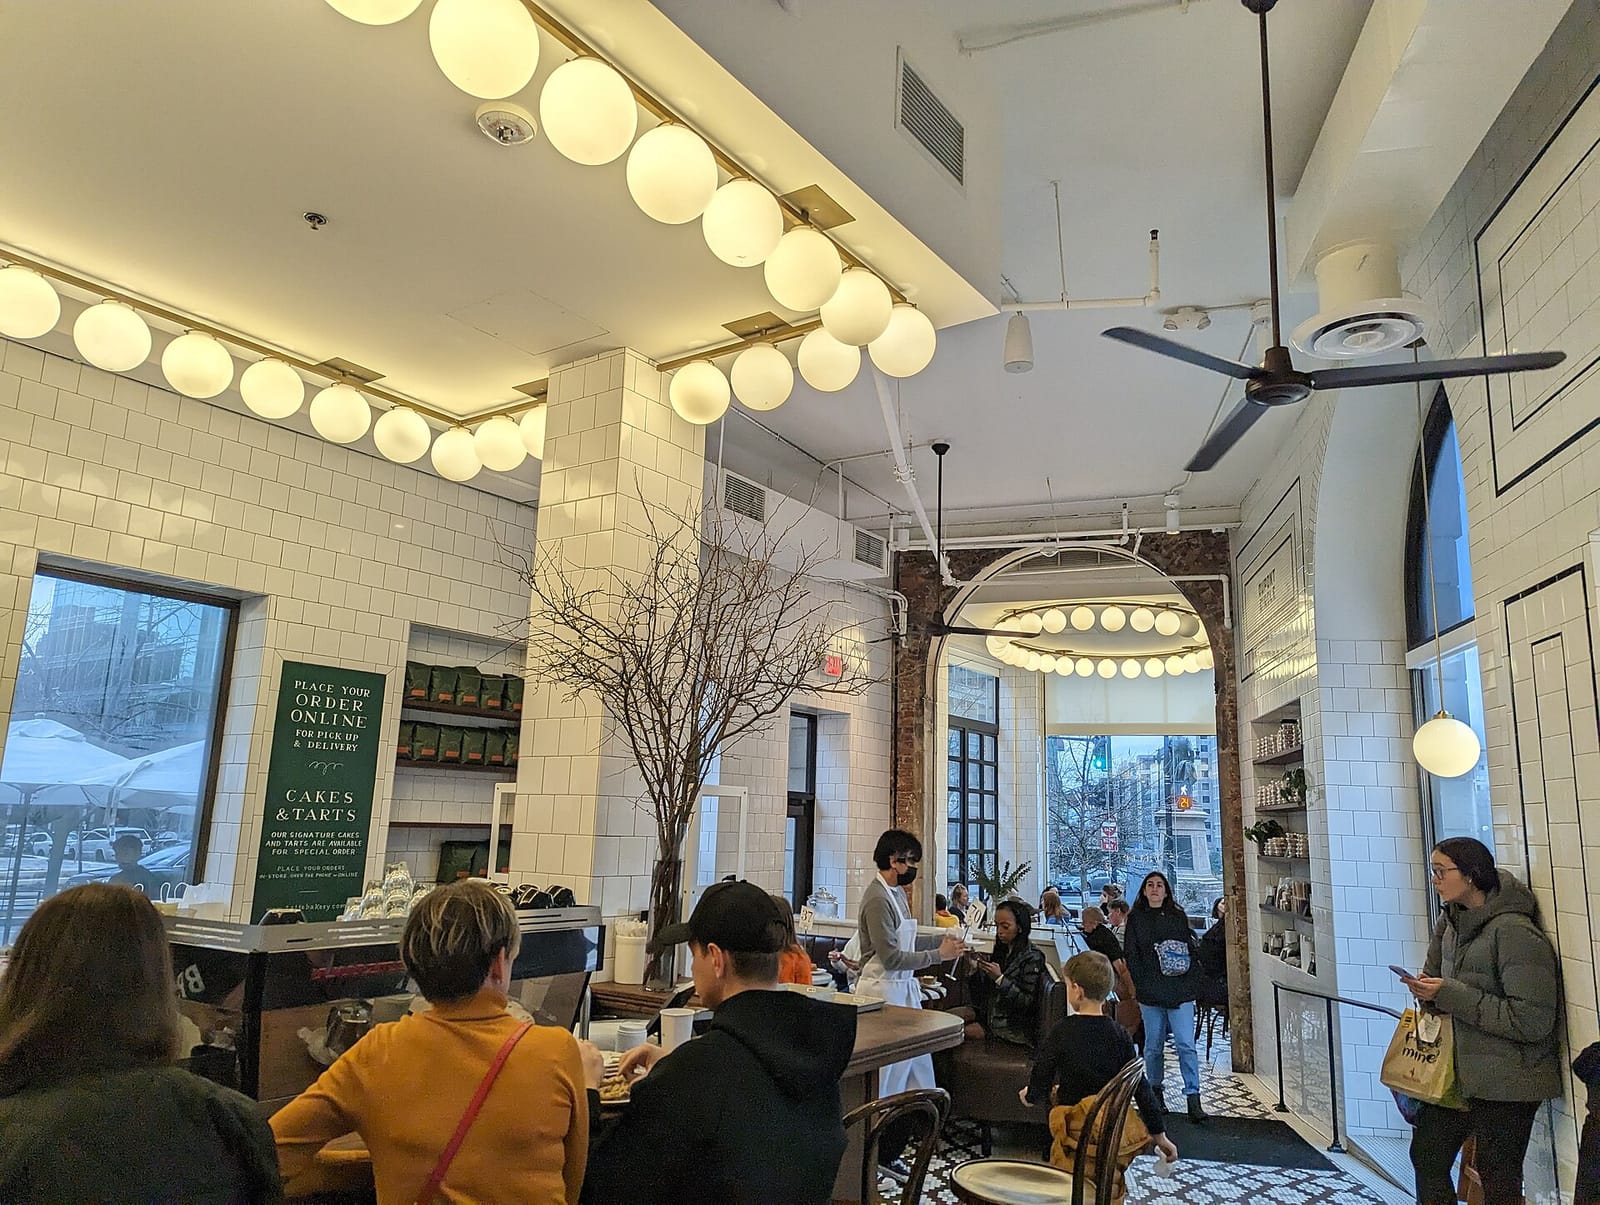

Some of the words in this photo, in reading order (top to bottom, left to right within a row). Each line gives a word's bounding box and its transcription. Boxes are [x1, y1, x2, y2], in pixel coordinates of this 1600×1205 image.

[294, 680, 335, 693] PLACE
[342, 686, 371, 698] YOUR
[296, 693, 363, 712] ORDER
[291, 709, 367, 728] ONLINE
[296, 729, 314, 738] FOR
[317, 731, 342, 740] PICK
[345, 733, 359, 741] UP
[293, 740, 301, 748] &
[308, 741, 358, 752] DELIVERY
[286, 789, 353, 804] CAKES
[1180, 797, 1189, 808] 24
[276, 808, 289, 821] &
[292, 808, 356, 821] TARTS
[272, 848, 288, 856] FOR
[294, 848, 330, 856] SPECIAL
[332, 848, 356, 856] ORDER
[801, 909, 814, 922] 37
